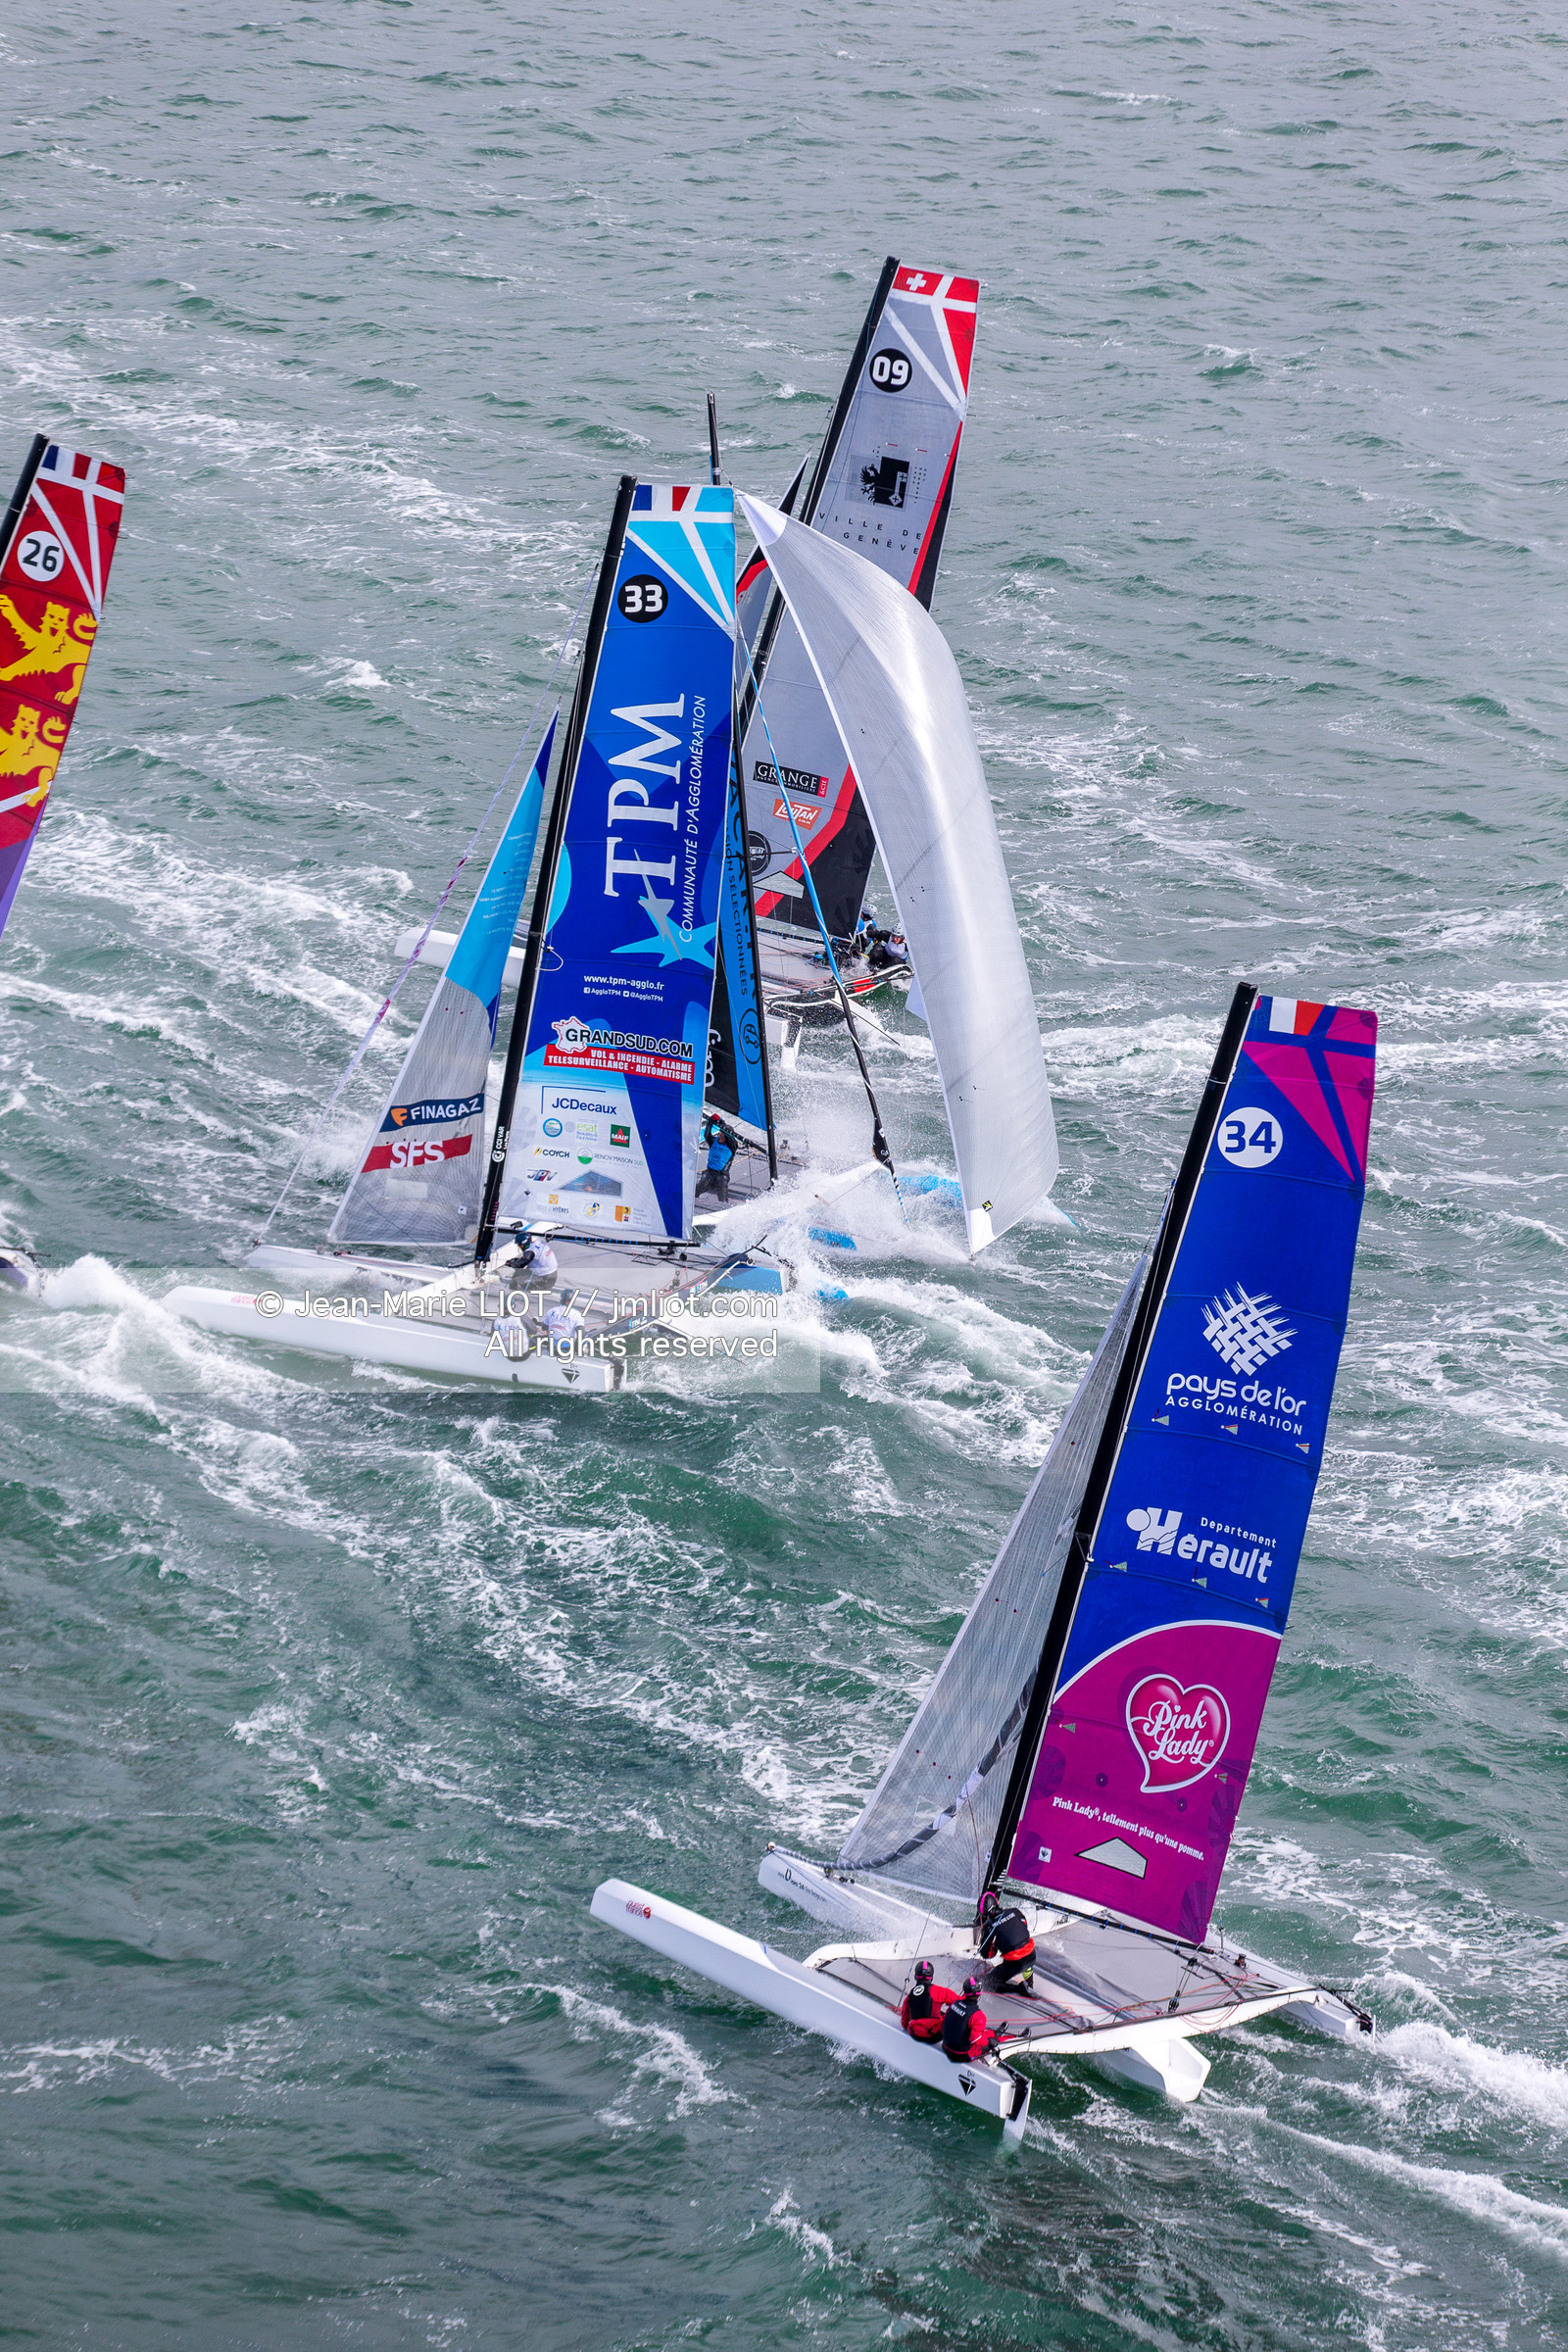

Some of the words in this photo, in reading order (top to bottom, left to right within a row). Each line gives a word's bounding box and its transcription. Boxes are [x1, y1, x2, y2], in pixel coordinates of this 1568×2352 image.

[872, 356, 909, 387] 09
[818, 512, 883, 532] VILLE
[902, 528, 922, 540] DE
[22, 538, 60, 572] 26
[843, 531, 919, 556] GENÈVE
[624, 584, 663, 613] 33
[685, 695, 707, 835] D'AGGLOMÉRATION
[758, 764, 817, 788] GRANGE
[604, 693, 685, 898] TPM
[679, 838, 699, 943] COMMUNAUTÉ
[728, 875, 748, 996] SÉLECTIONNÉES
[584, 975, 664, 991] www.tpm-agglo.fr
[591, 988, 621, 997] AggloTPM
[565, 1028, 693, 1058] GRANDSUD.COM
[548, 1055, 629, 1071] TELESURVEILLANCE
[636, 1065, 692, 1082] AUTOMATISME
[591, 1050, 607, 1058] VOL
[617, 1053, 655, 1066] INCENDIE
[662, 1060, 693, 1073] ALARME
[411, 1098, 481, 1120] FINAGAZ
[552, 1098, 617, 1115] JCDecaux
[1225, 1119, 1277, 1154] 34
[389, 1141, 445, 1169] SFS
[542, 1149, 570, 1158] COYCH
[1166, 1373, 1237, 1400] pays
[1241, 1380, 1272, 1406] de
[1274, 1387, 1307, 1416] l'or
[1165, 1396, 1302, 1436] AGGLOMÉRATION
[1143, 1700, 1207, 1737] Pink
[1052, 1796, 1073, 1811] Pink
[1102, 1812, 1139, 1833] tellement
[1139, 1826, 1154, 1838] plus
[1154, 1834, 1178, 1849] qu'une
[1177, 1841, 1204, 1861] pomme.
